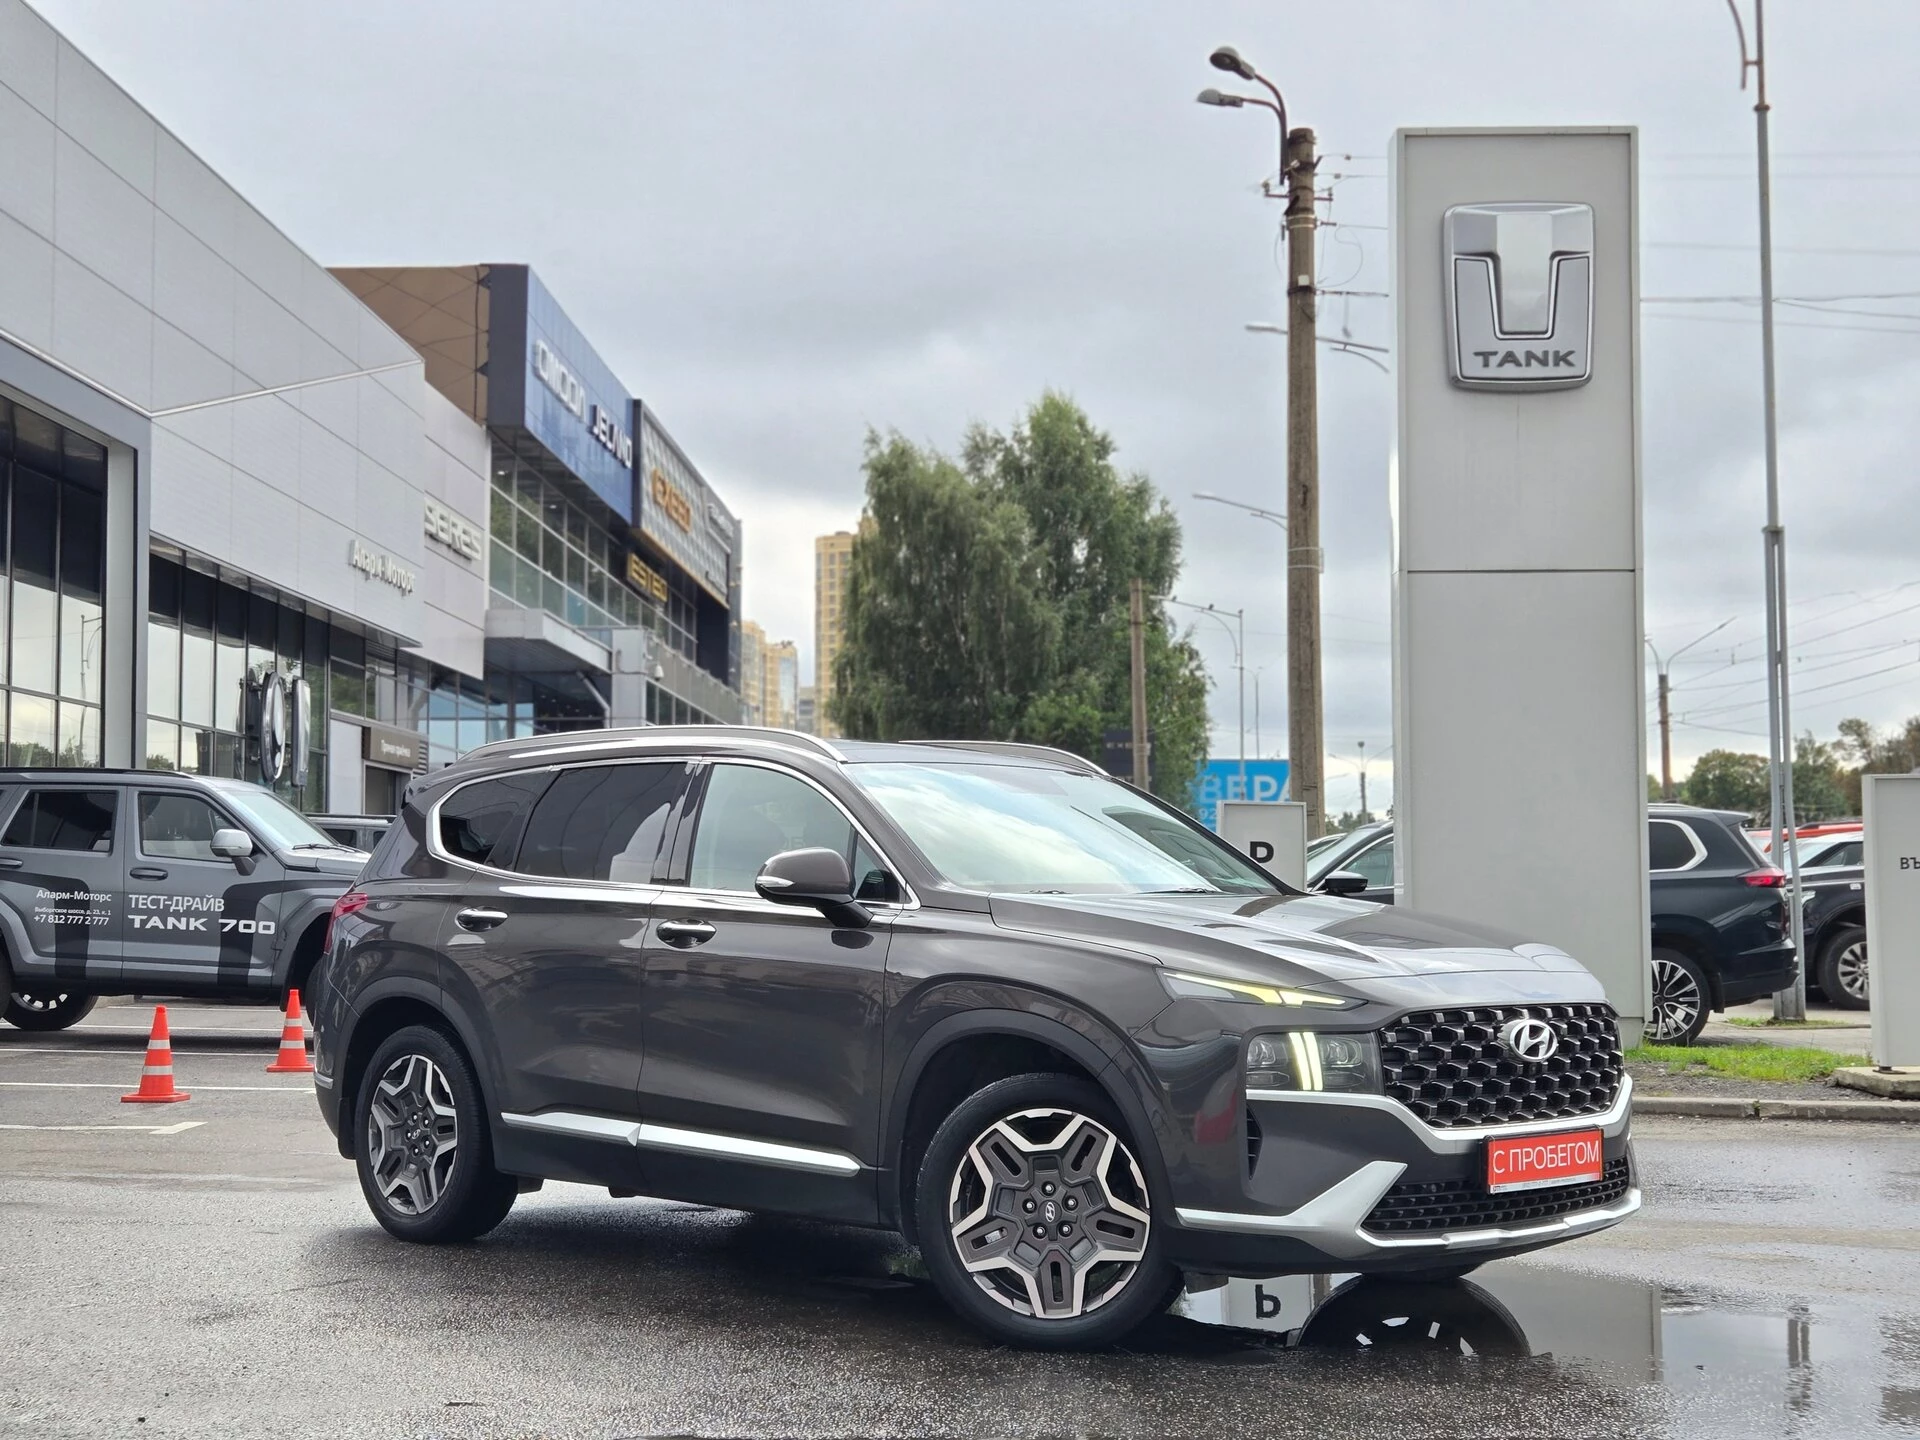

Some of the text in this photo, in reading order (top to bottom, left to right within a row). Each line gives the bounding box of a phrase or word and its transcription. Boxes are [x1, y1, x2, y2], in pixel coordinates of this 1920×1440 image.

[1473, 350, 1576, 368] TANK
[423, 496, 482, 562] SERES
[36, 889, 112, 903] Аларм-Моторс
[128, 894, 225, 913] ТЕСТ-ДРАЙВ
[34, 906, 67, 914] Выборгское
[34, 914, 109, 926] +7 812 777 2 777
[127, 914, 276, 935] TANK 700
[1492, 1140, 1600, 1174] С ПРОБЕГОМ
